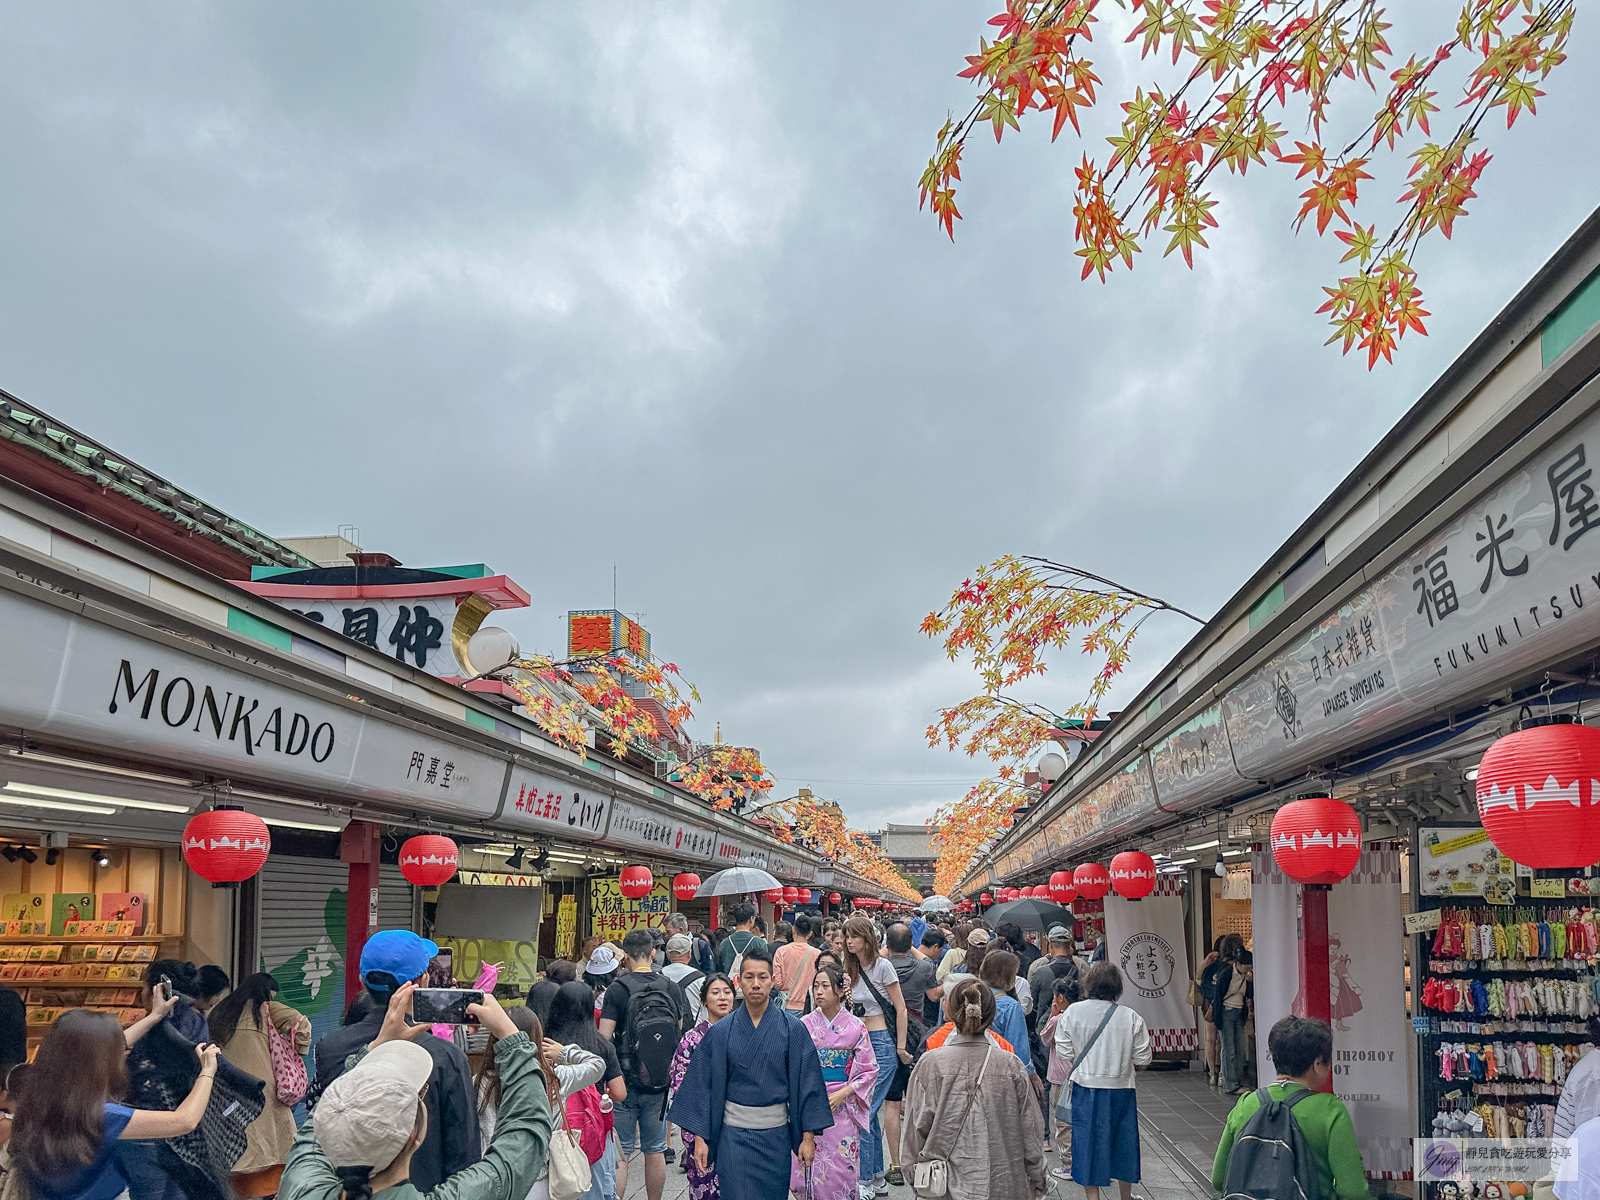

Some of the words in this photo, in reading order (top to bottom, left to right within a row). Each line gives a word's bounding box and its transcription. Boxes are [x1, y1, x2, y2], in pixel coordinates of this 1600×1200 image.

[1412, 443, 1600, 628] 福光屋
[1310, 615, 1376, 683] 日本式雑貨
[108, 659, 335, 763] MONKADO
[1322, 691, 1350, 717] JAPANESE
[1350, 670, 1385, 703] SOUVENIRS
[406, 750, 455, 788] 門嘉堂
[515, 782, 562, 820] 美術工芸品
[568, 792, 604, 832] こいけ
[1135, 953, 1146, 979] 化粧堂
[1146, 945, 1158, 985] よろし
